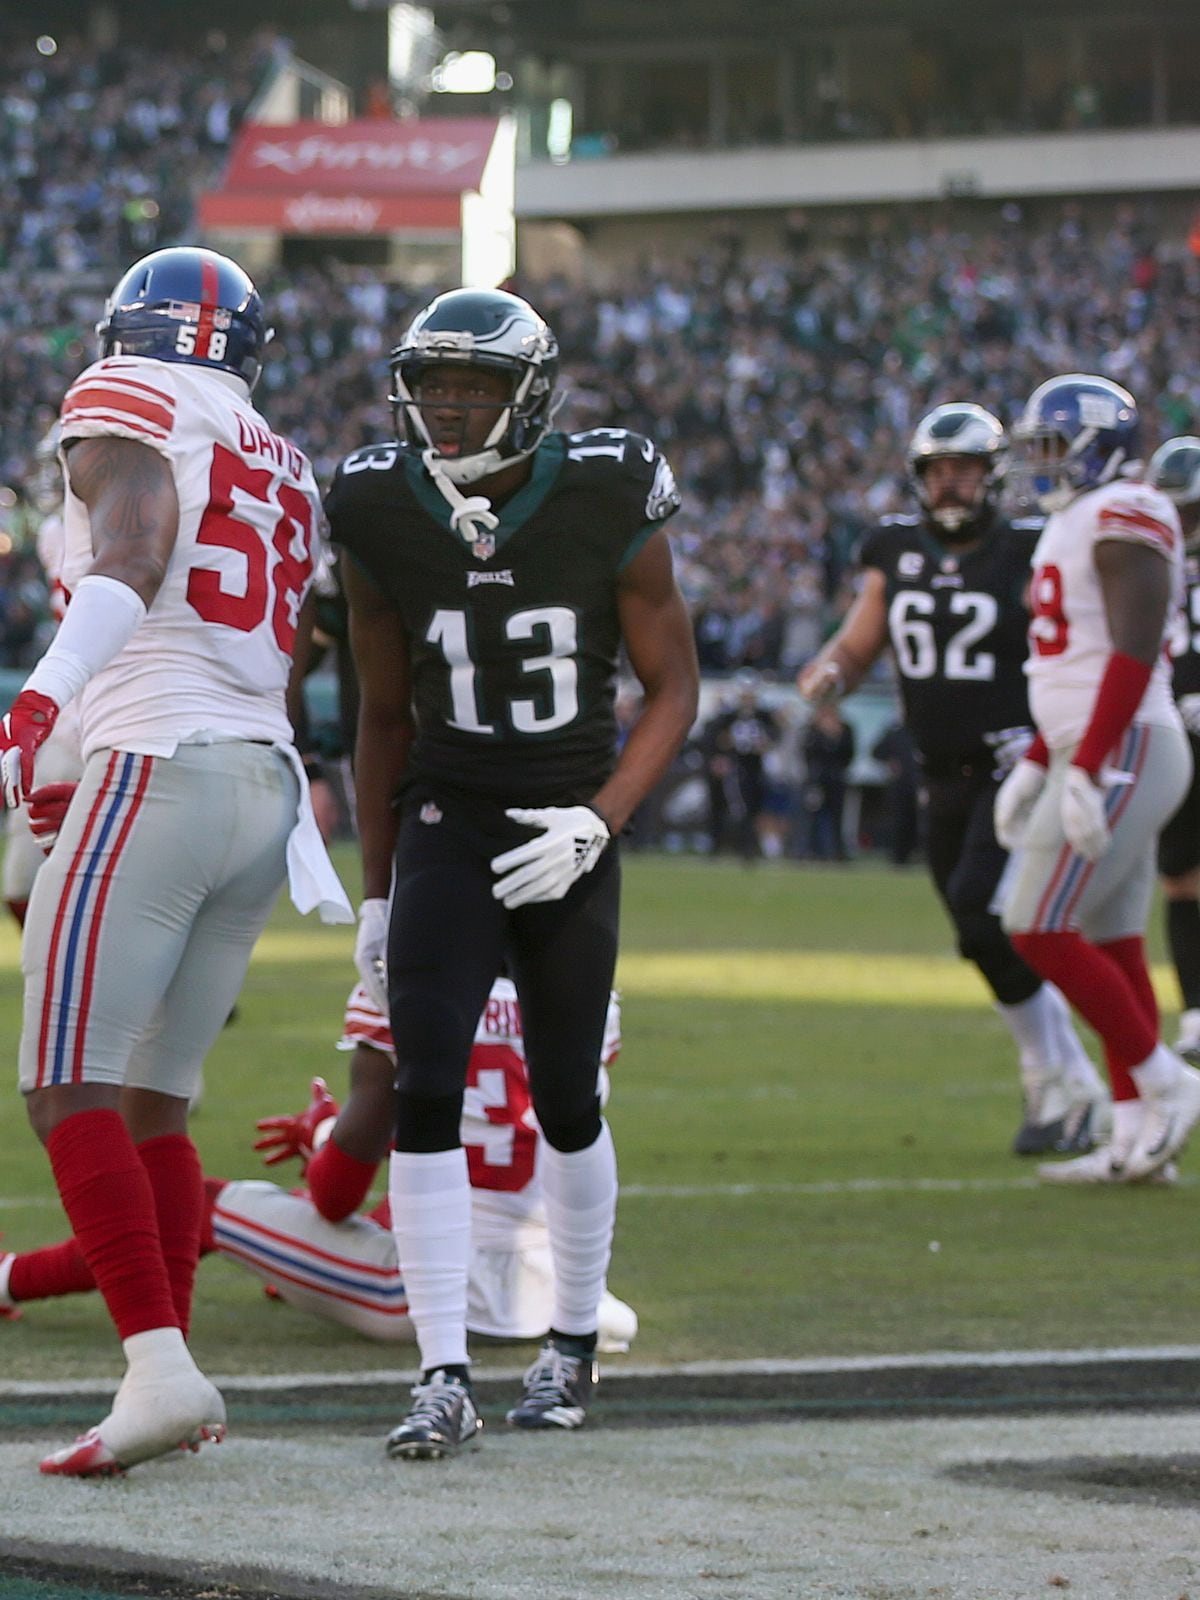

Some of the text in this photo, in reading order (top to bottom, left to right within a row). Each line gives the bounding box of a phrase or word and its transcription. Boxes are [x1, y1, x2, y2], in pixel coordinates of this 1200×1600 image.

[175, 325, 228, 361] 58
[187, 442, 313, 657] 58
[425, 606, 578, 734] 13
[889, 590, 998, 681] 62
